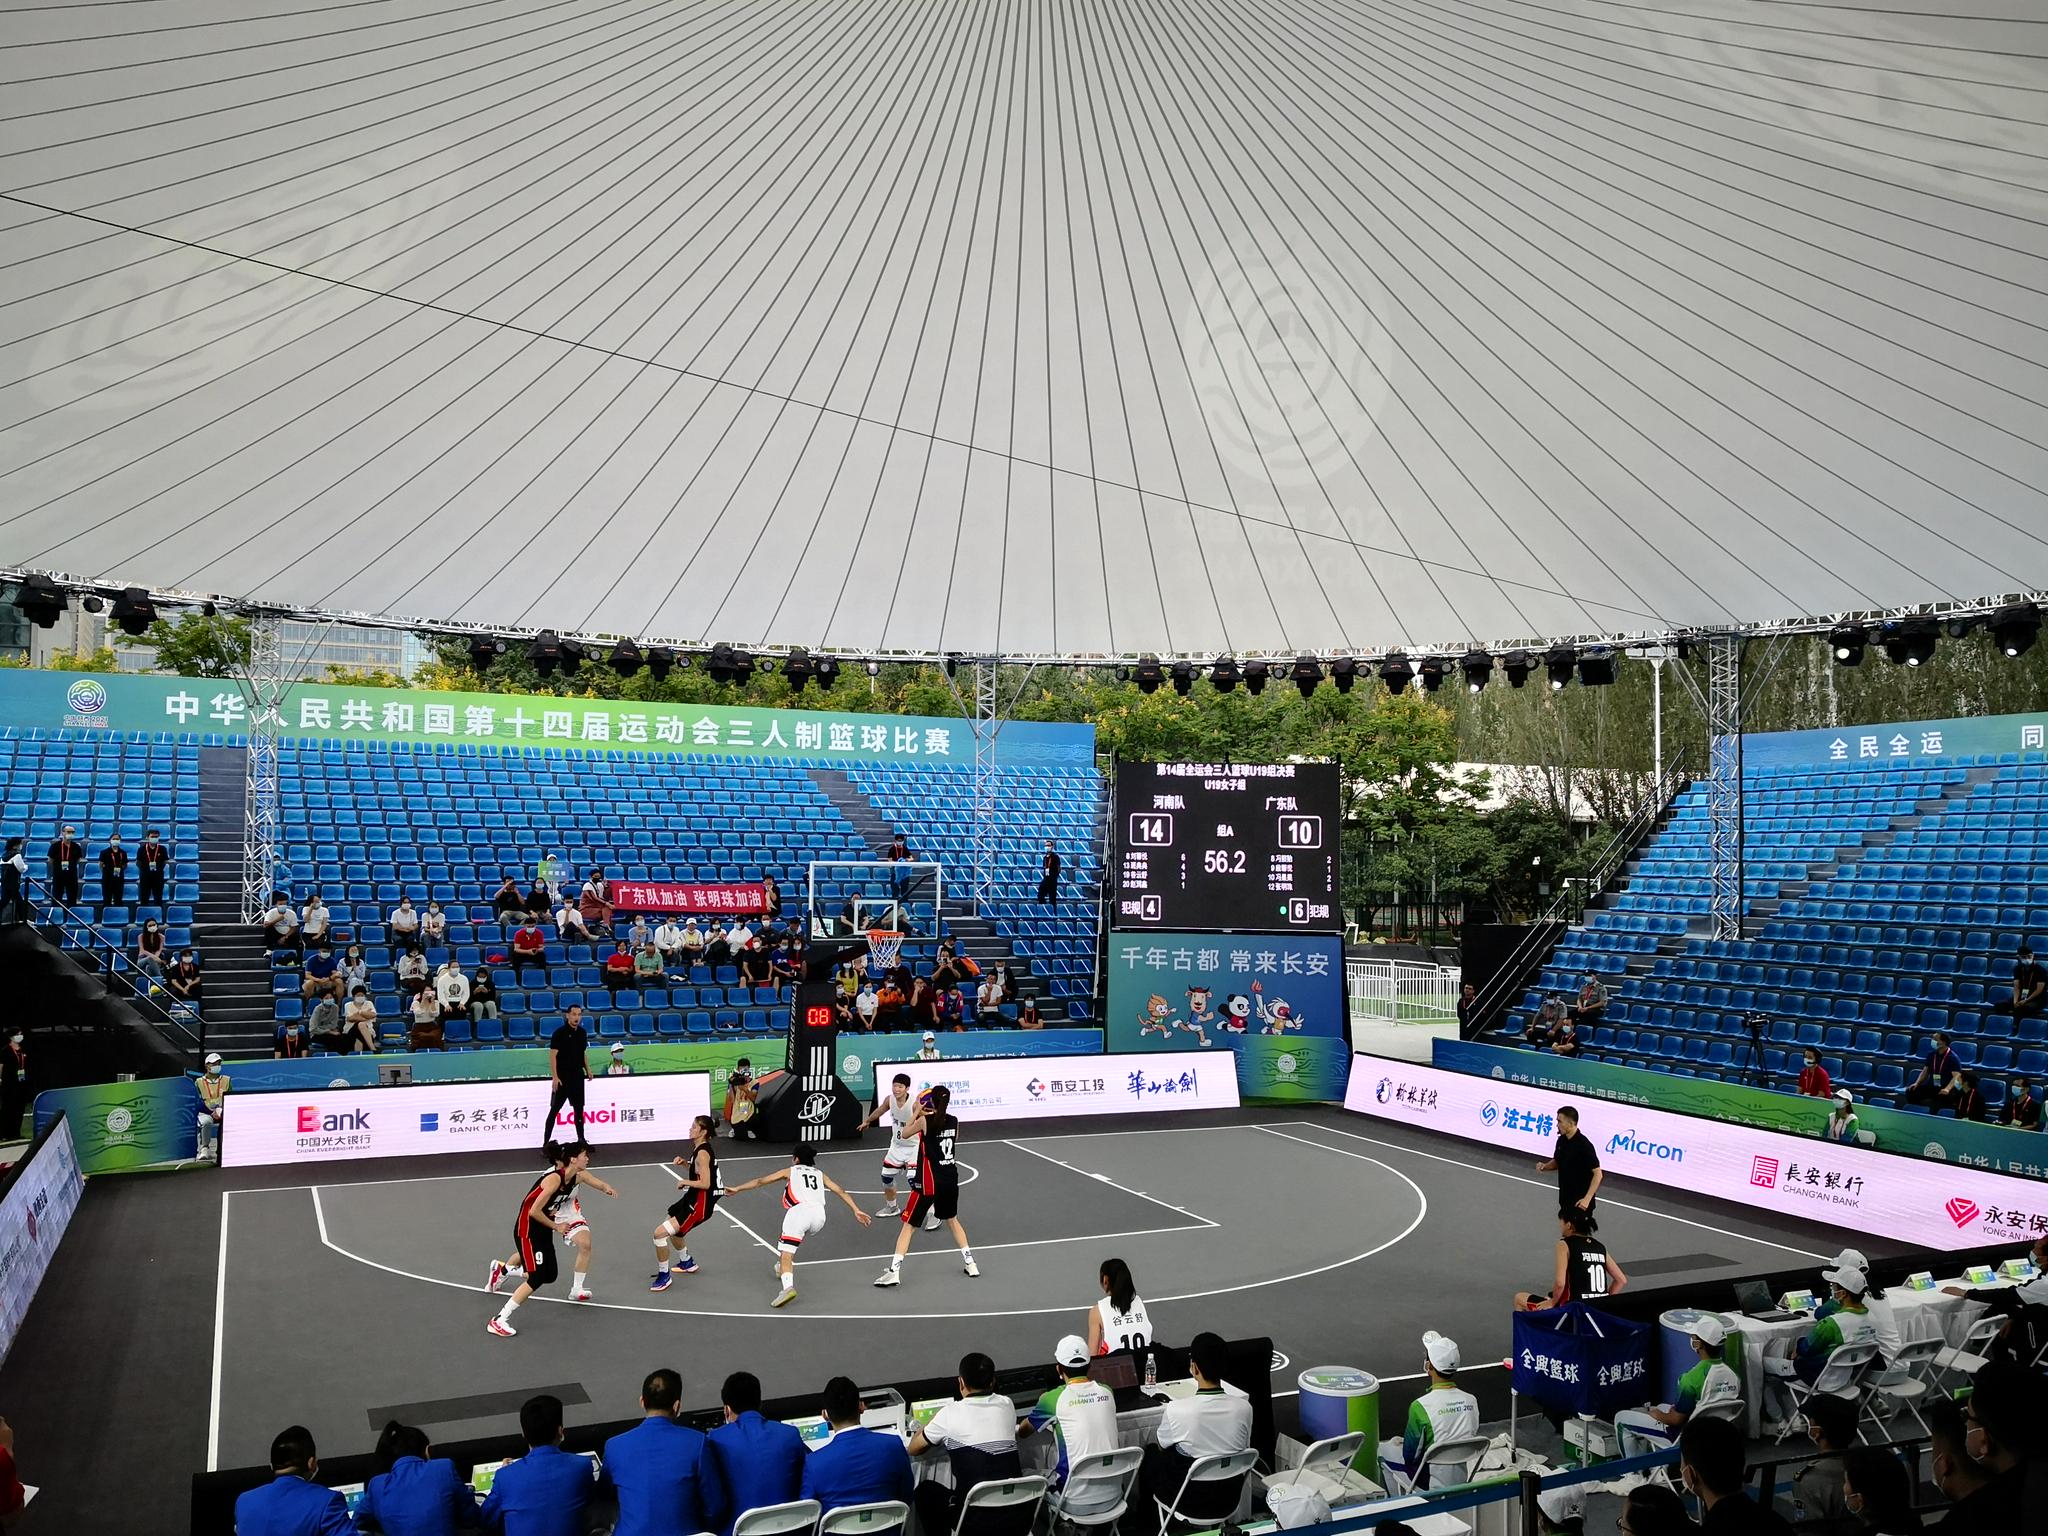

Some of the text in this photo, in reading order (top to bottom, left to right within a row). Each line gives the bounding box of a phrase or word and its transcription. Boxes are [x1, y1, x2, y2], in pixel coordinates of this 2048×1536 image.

[1829, 724, 2044, 760] 全民全运 同
[1156, 764, 1295, 778] 第14届全运会三人篮球U19组决赛
[1204, 779, 1246, 790] U19女子组
[1153, 795, 1298, 811] 河南队 广东队
[1140, 819, 1312, 844] 14 10
[1216, 824, 1234, 837] 组A
[1204, 850, 1246, 874] 56.2
[1326, 856, 1332, 864] 2
[1326, 874, 1332, 882] 2
[1326, 884, 1332, 892] 5
[618, 886, 762, 908] 广东队加油 张明珠加油
[1122, 900, 1156, 915] 犯规 4
[1295, 902, 1330, 918] 6 犯规
[1121, 947, 1329, 977] 千年古都 常来长安
[808, 1008, 828, 1024] 08
[1051, 1079, 1105, 1092] 西安工投
[620, 1108, 655, 1122] 隆基
[1502, 1107, 1553, 1136] 法士特
[450, 1126, 480, 1134] BANK
[501, 1123, 528, 1131] XI'AN
[297, 1134, 371, 1147] 中国光大银行
[1609, 1131, 1684, 1162] Micron
[940, 1138, 953, 1160] 12
[802, 1174, 818, 1190] 13
[1784, 1163, 1864, 1196] 長安銀行
[1783, 1184, 1859, 1208] CHANG'AN BANK
[1984, 1206, 2048, 1233] 永安保
[1983, 1226, 2006, 1238] YONG
[536, 1252, 543, 1264] 9
[1588, 1264, 1605, 1292] 10
[1112, 1312, 1143, 1326] 谷云舒
